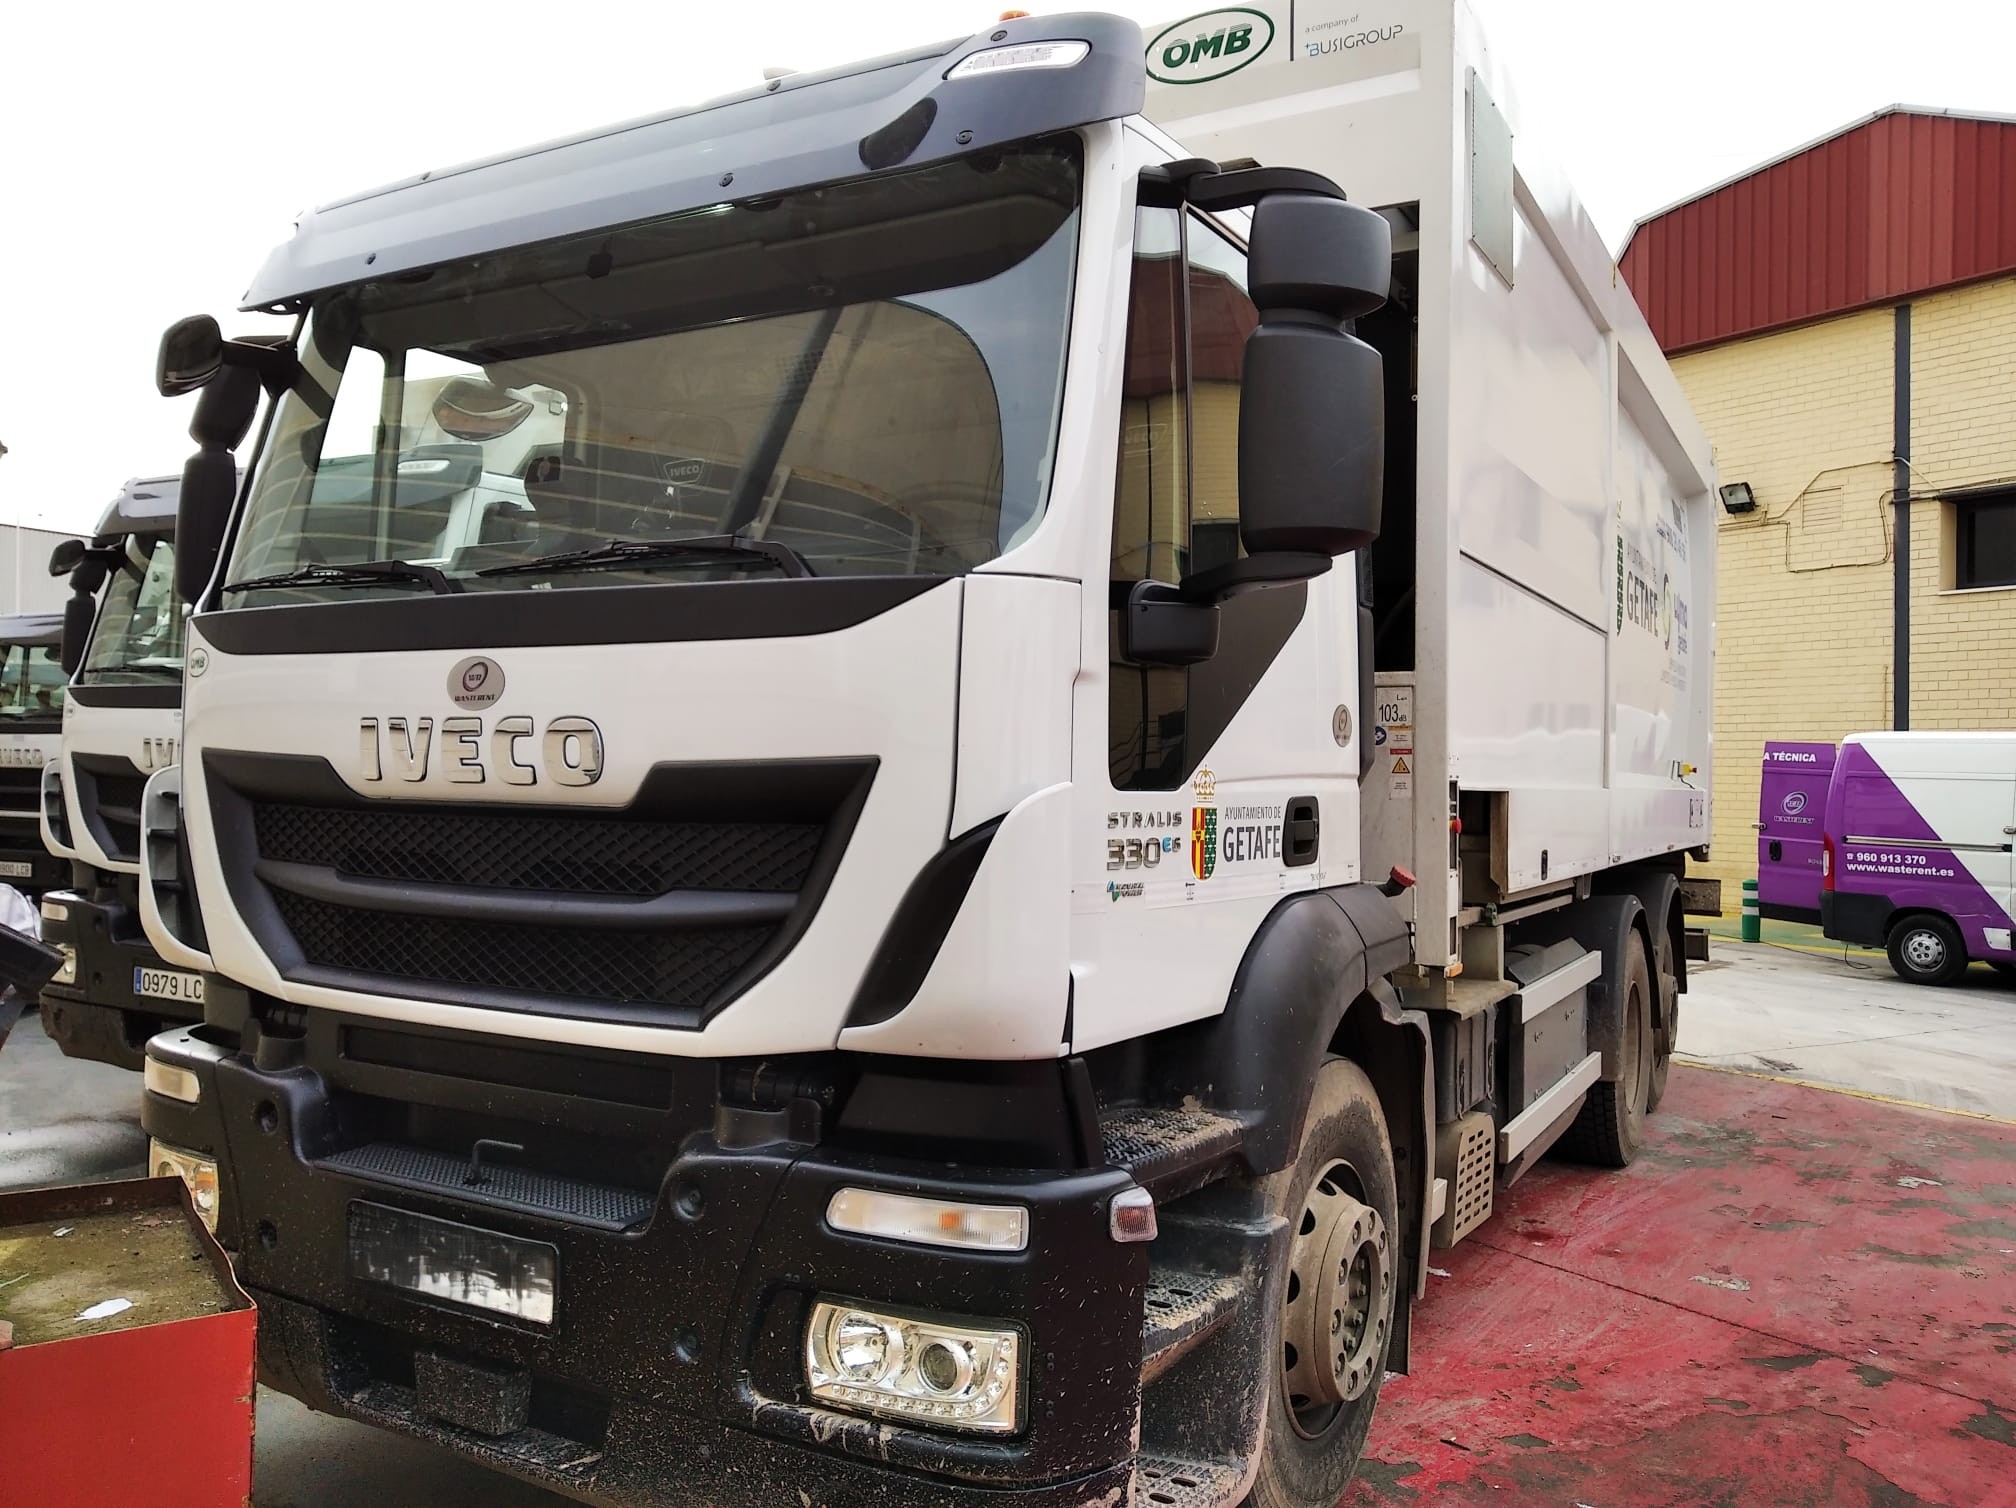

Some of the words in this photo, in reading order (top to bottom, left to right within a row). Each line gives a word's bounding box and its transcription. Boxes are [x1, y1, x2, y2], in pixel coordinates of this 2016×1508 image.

[1311, 18, 1348, 32] company
[1350, 14, 1359, 23] of
[1162, 23, 1252, 68] OMB
[1309, 24, 1403, 56] BUSIGROUP
[670, 465, 700, 477] IVECO
[1626, 570, 1658, 637] GETAFE
[1379, 703, 1399, 722] 103
[143, 737, 181, 768] IV
[359, 715, 605, 787] IVECO
[1772, 751, 1816, 762] TÉCNICA
[1107, 810, 1182, 829] STRALIS
[1225, 806, 1273, 820] AYUNTAMIENTO
[1273, 806, 1281, 819] DE
[1223, 825, 1281, 862] GETAFE
[1856, 852, 1877, 862] 960
[1880, 853, 1901, 864] 913
[1905, 855, 1926, 865] 370
[1846, 863, 1955, 877] www.wasterent.es
[142, 972, 178, 996] 0979
